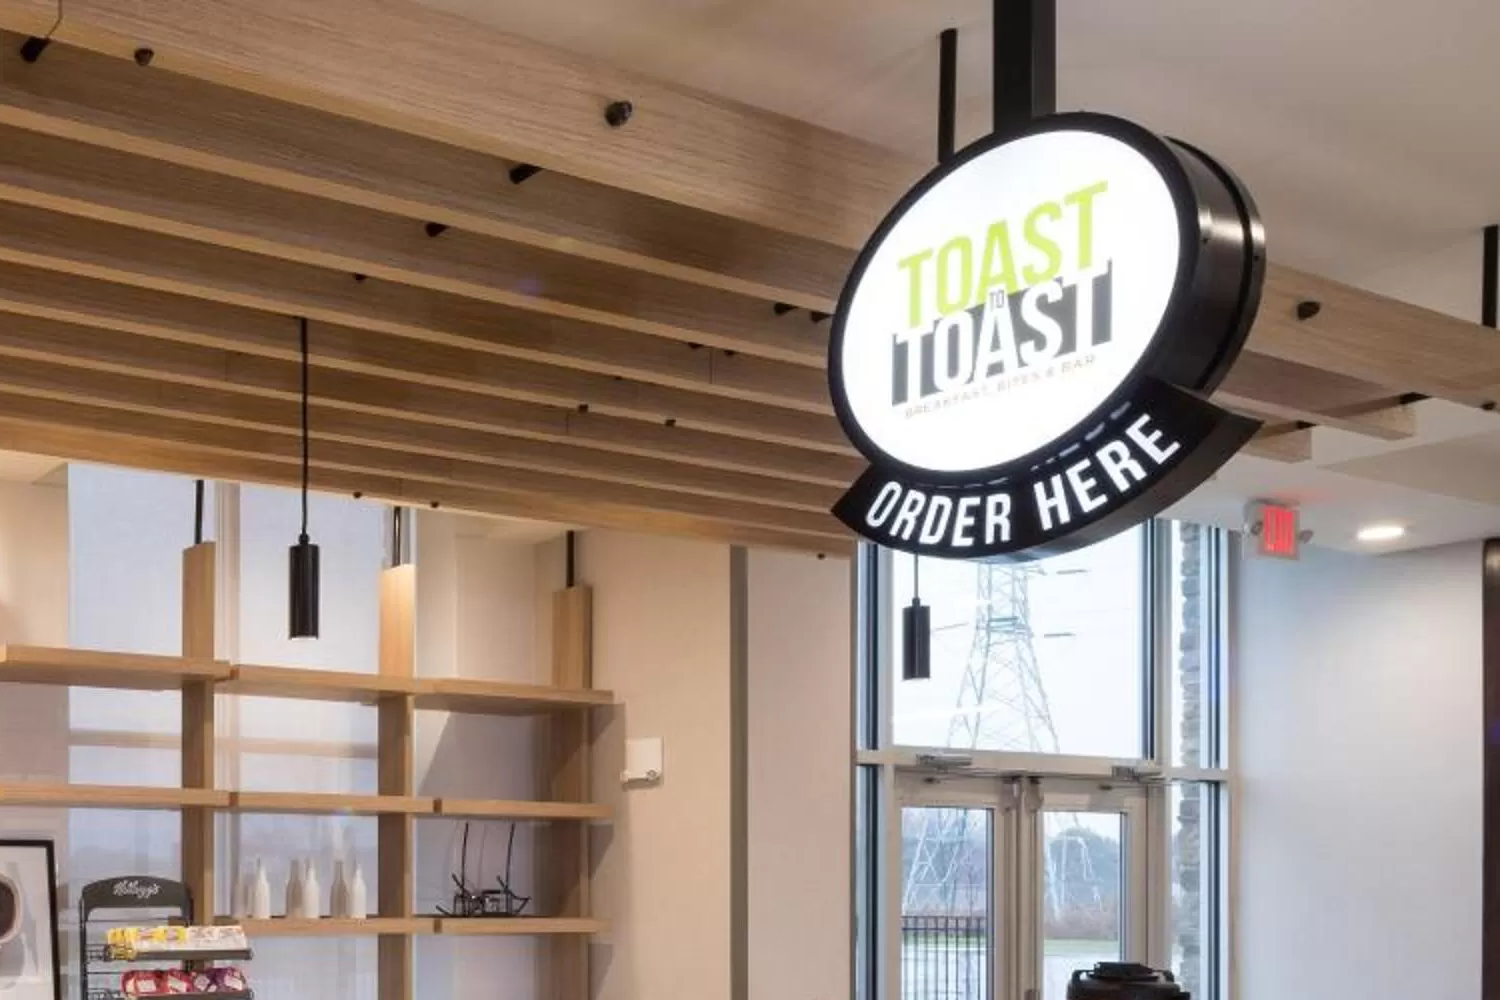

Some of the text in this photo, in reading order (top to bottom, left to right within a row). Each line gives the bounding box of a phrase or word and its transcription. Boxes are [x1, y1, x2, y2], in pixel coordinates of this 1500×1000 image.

[897, 180, 1109, 329] TOAST
[989, 289, 1005, 310] TO
[892, 260, 1113, 406] TOAST
[865, 481, 1013, 547] ORDER
[1033, 413, 1182, 532] HERE
